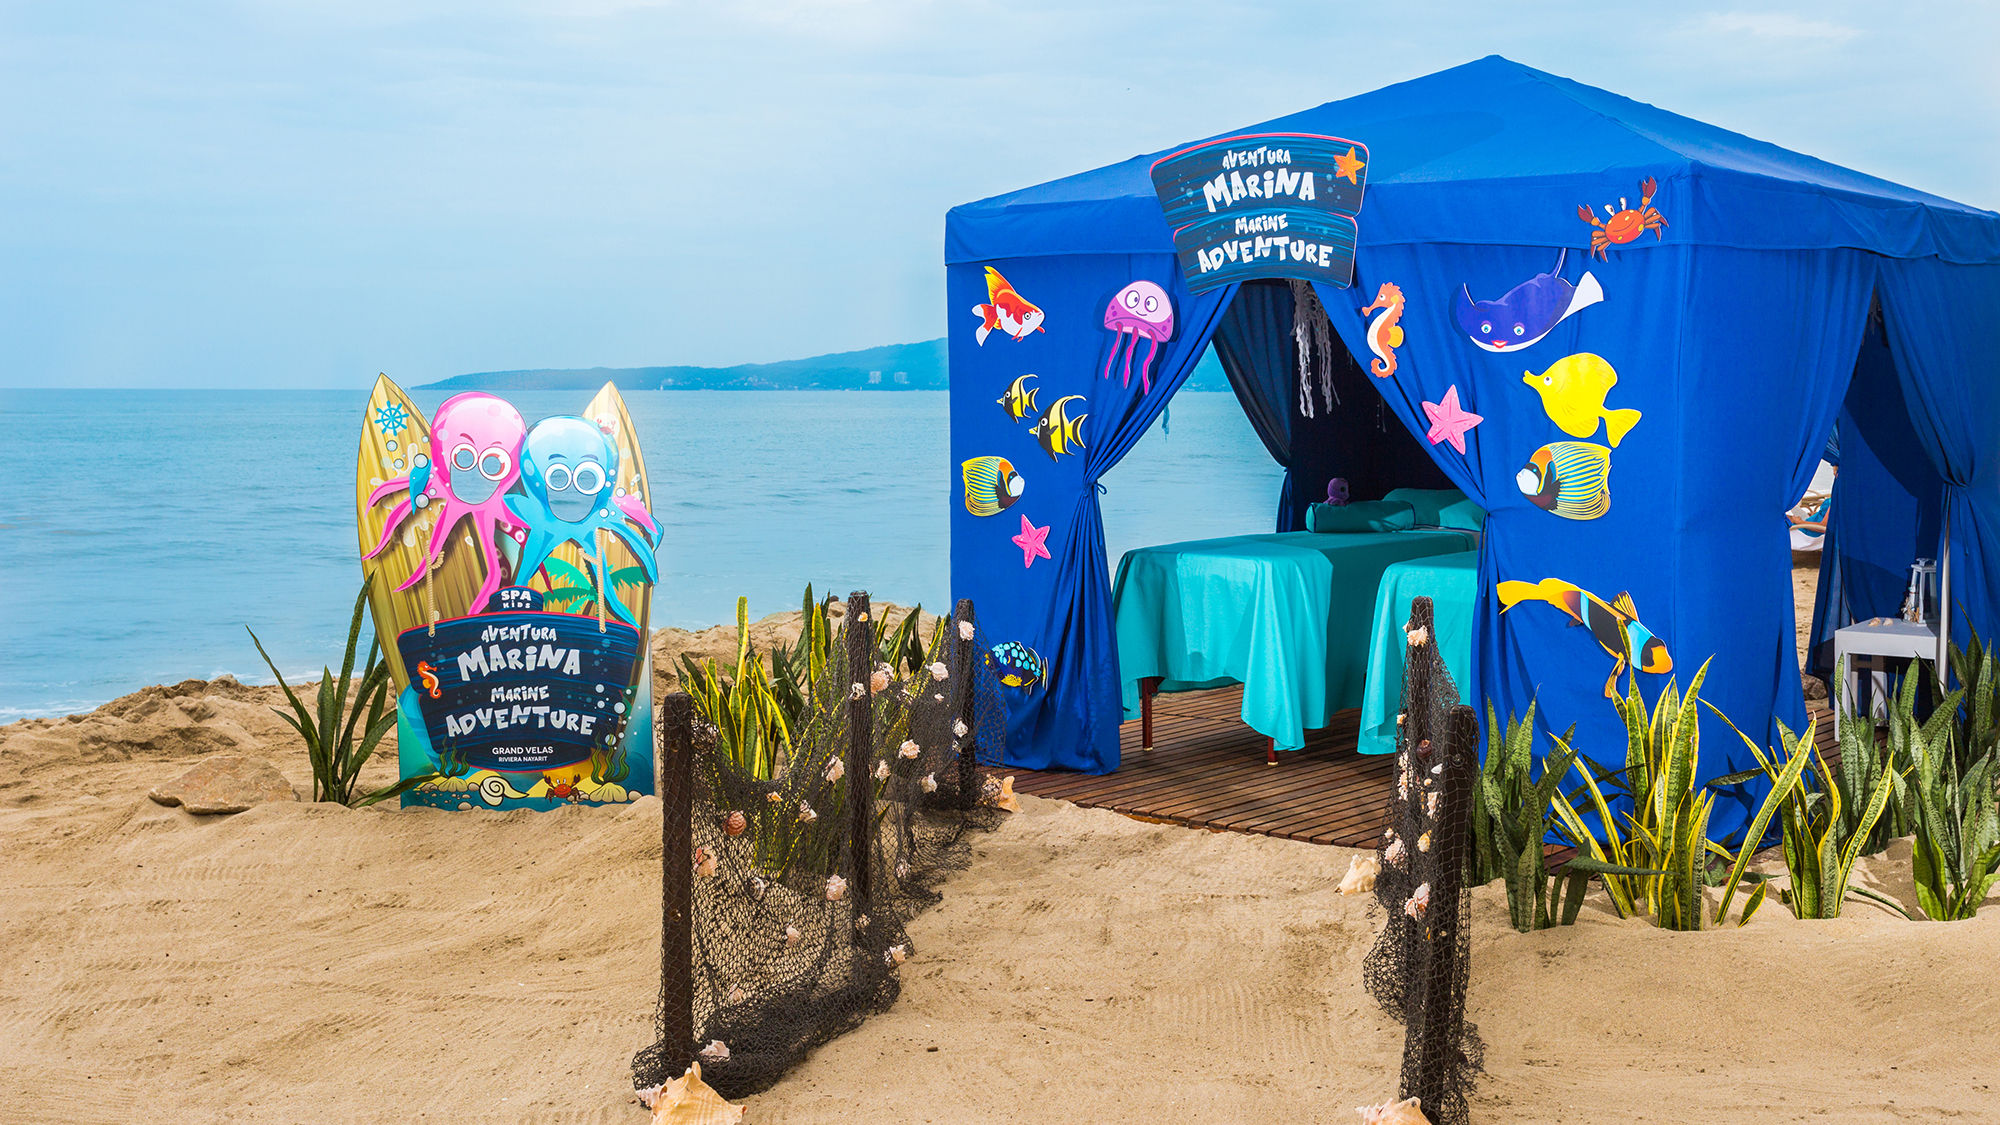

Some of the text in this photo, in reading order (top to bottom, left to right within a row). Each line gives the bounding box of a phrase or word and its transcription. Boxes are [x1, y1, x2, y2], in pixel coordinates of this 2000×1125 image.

[1222, 146, 1292, 169] AVENTURA
[1197, 236, 1334, 273] ADVENTURE
[500, 590, 532, 601] SPA
[481, 624, 557, 642] AVENTURA
[445, 704, 597, 737] ADVENTURE
[491, 746, 554, 755] GRAND VELAS
